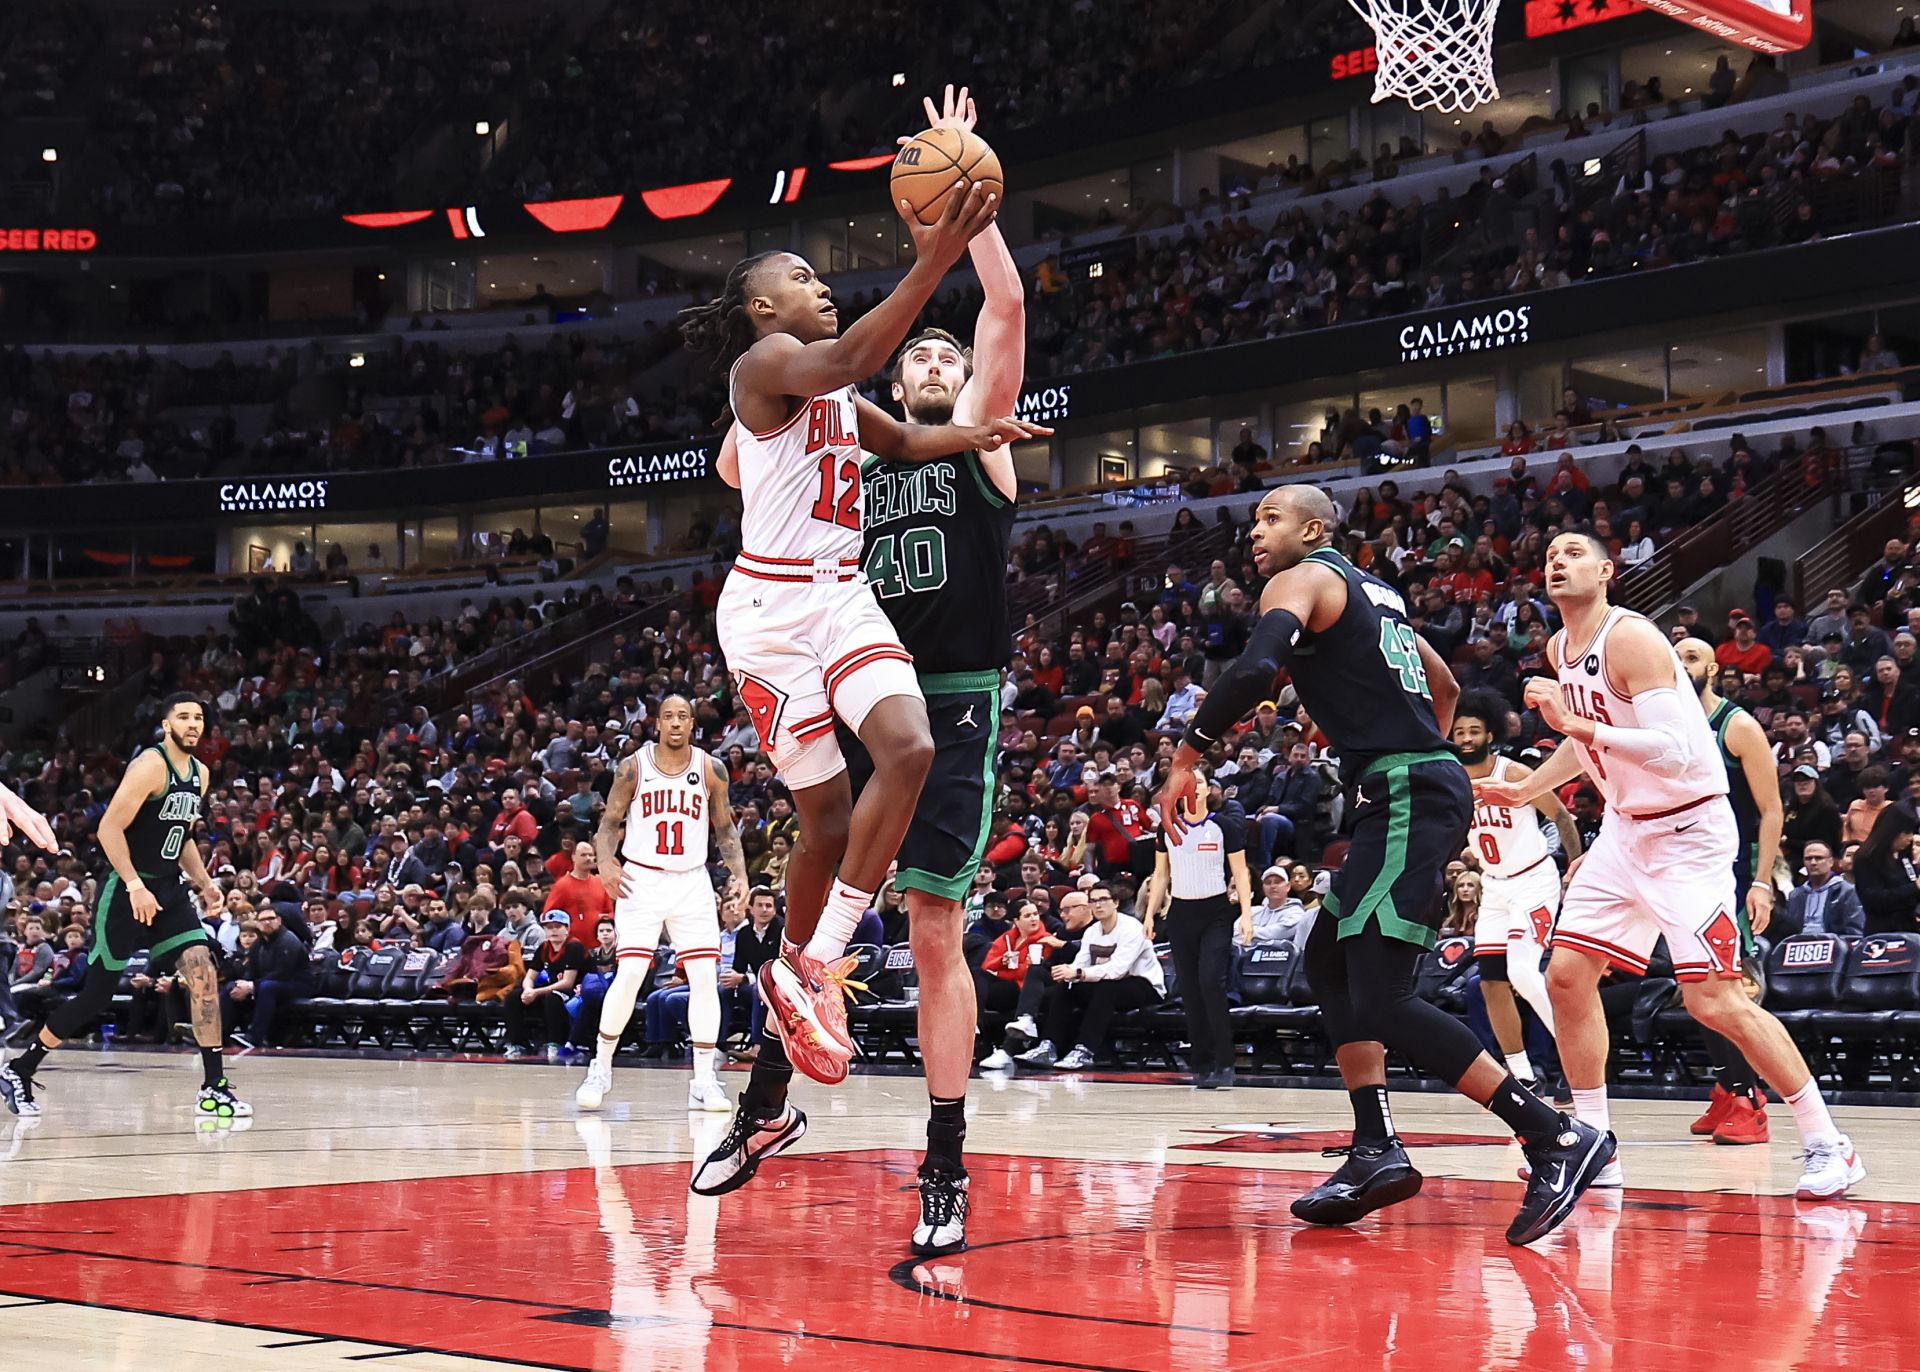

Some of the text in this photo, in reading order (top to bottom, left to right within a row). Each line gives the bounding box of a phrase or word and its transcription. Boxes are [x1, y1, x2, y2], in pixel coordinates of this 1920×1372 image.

[43, 228, 96, 250] RED
[1400, 306, 1529, 349] CALAMOS
[1402, 331, 1529, 362] INVESTMENTS
[608, 448, 707, 476] CALAMOS
[609, 468, 705, 486] INVESTMENTS
[220, 480, 328, 502] CALAMOS
[811, 452, 862, 531] 12
[864, 525, 948, 599] 40
[1379, 616, 1434, 703] 42
[641, 789, 702, 820] BULLS
[160, 825, 185, 860] 0
[656, 820, 684, 855] 11
[1478, 833, 1501, 864] 0
[892, 952, 911, 966] USO
[1794, 944, 1823, 962] USO
